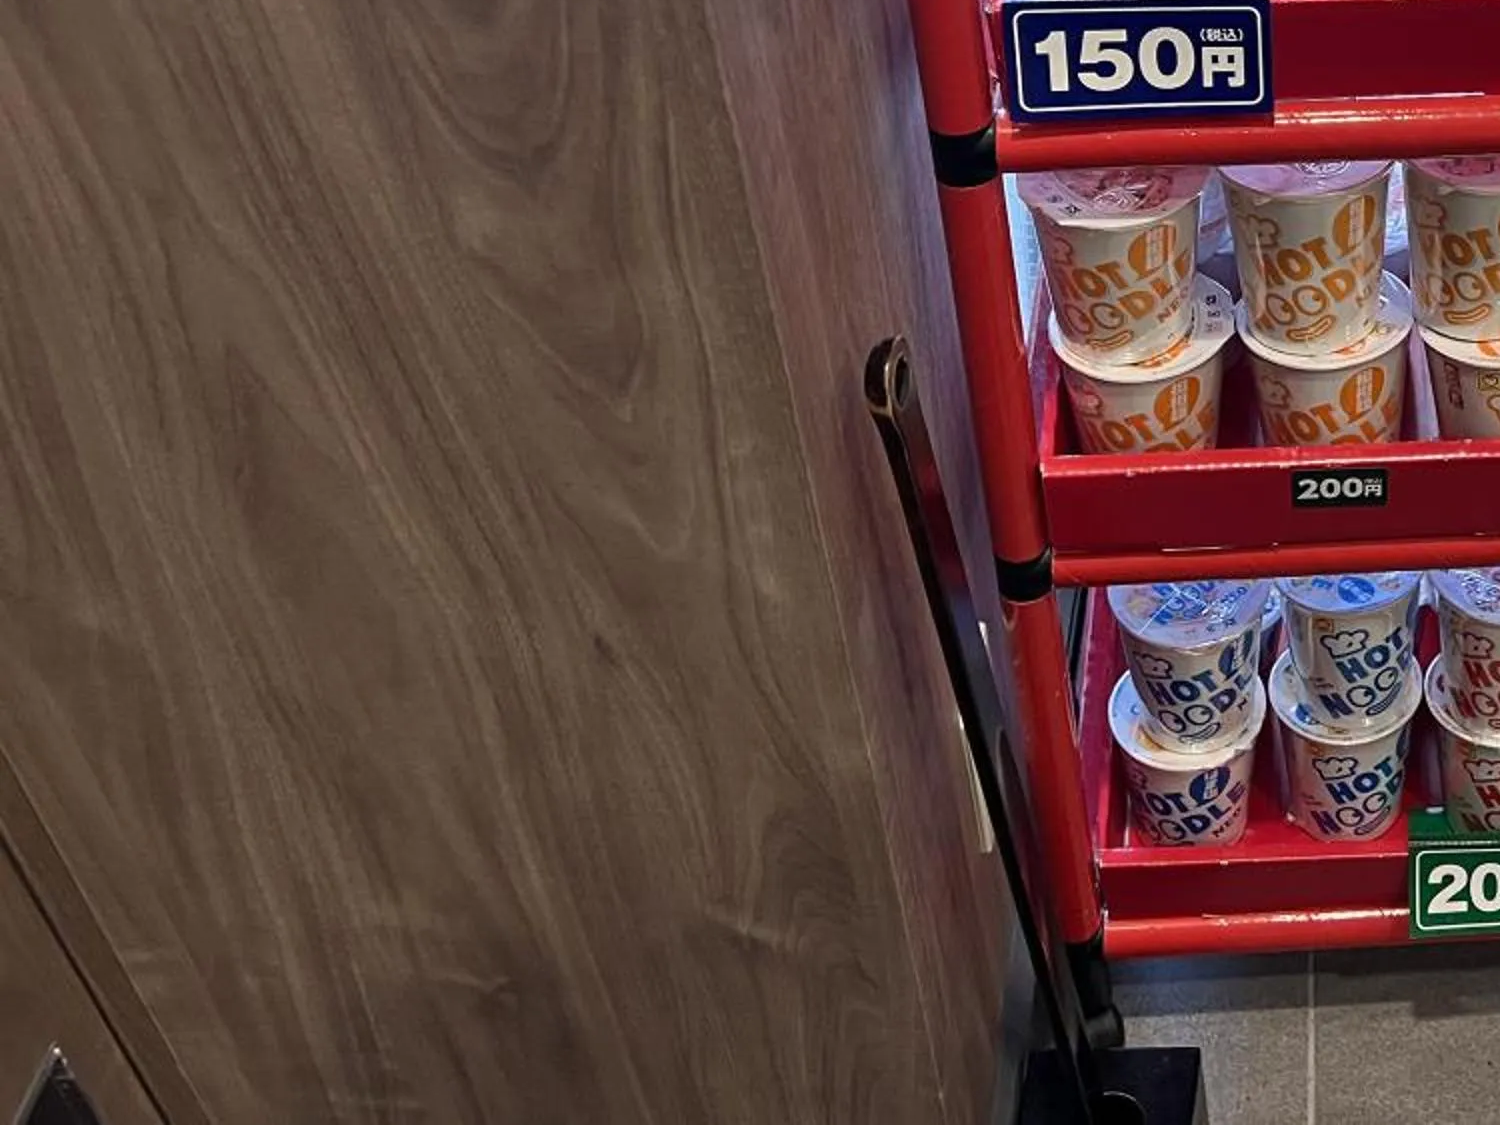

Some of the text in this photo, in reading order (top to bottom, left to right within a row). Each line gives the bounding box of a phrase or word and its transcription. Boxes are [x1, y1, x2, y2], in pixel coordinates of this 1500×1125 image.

[1054, 260, 1130, 301] HOT
[1257, 236, 1333, 289] HOT
[1335, 626, 1403, 684] HOT
[1145, 668, 1218, 706] HOT
[1325, 756, 1393, 805] HOT
